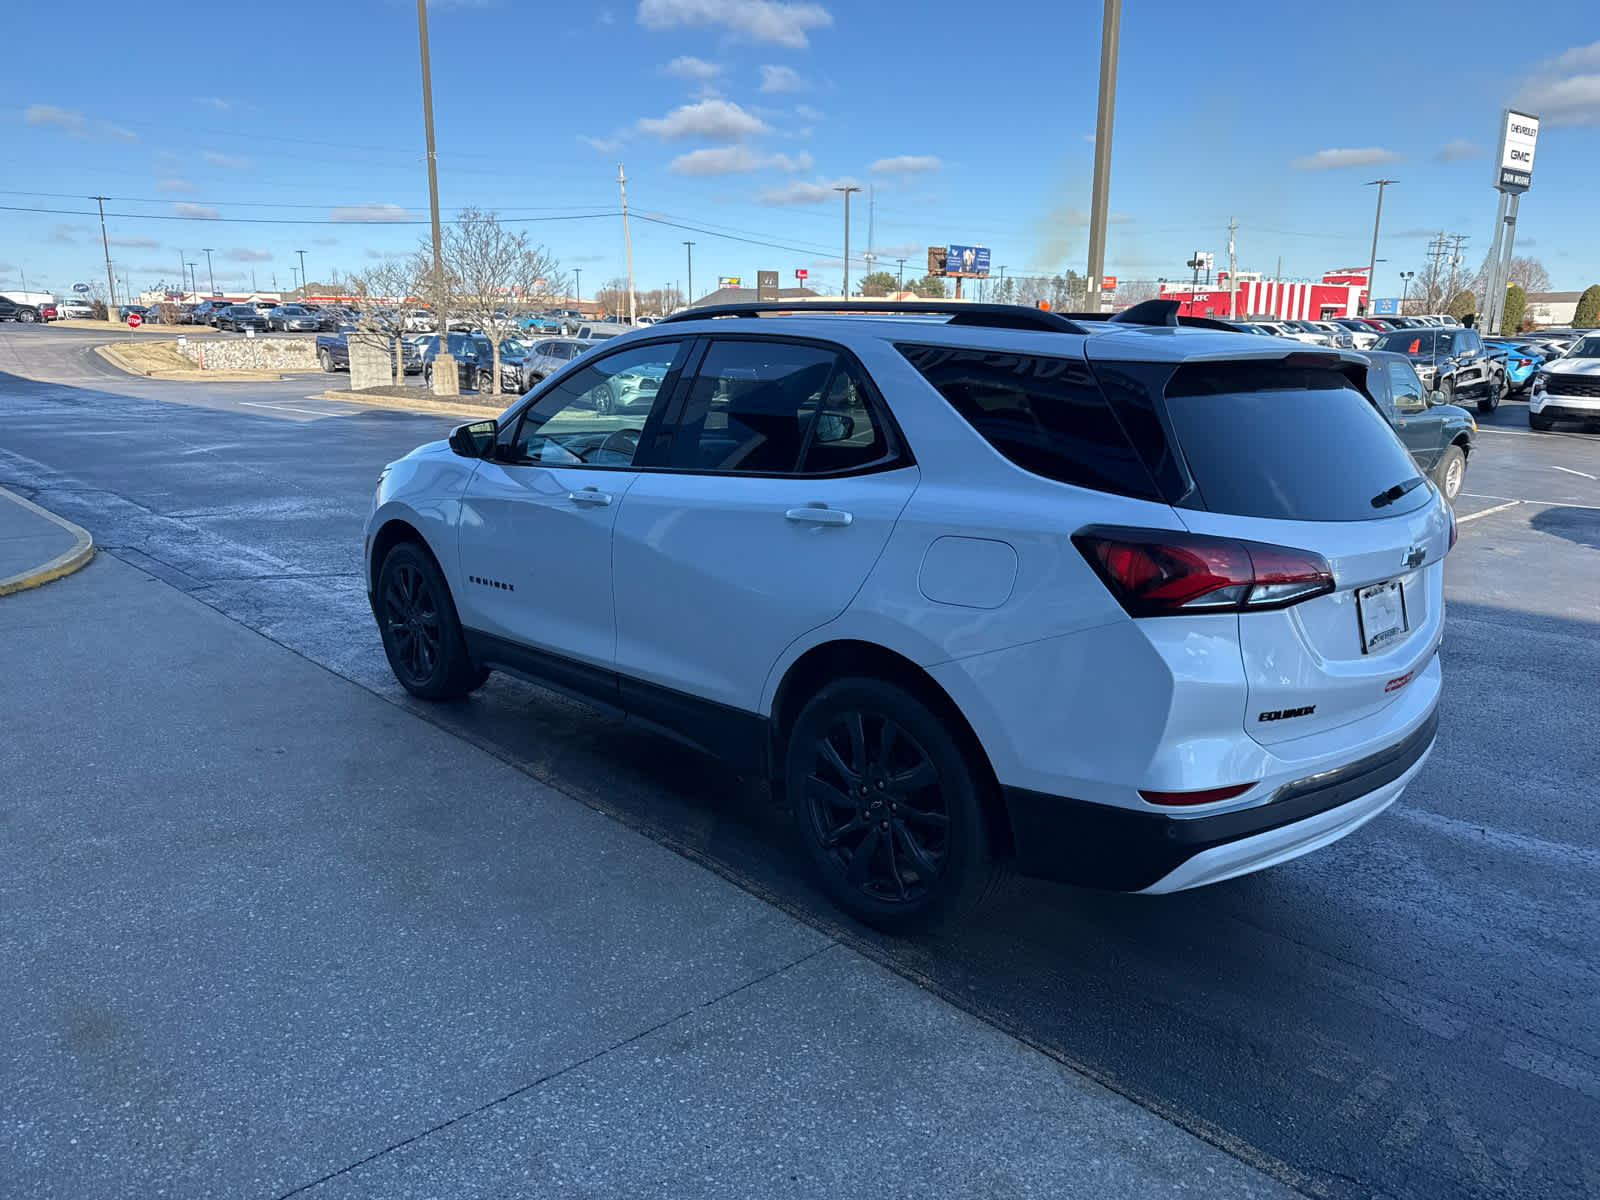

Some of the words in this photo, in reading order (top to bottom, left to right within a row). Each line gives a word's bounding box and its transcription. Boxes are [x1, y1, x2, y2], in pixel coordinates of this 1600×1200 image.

[1511, 123, 1536, 136] CHEVROLET
[1511, 150, 1530, 162] GMC
[1503, 172, 1514, 183] DON
[1514, 174, 1530, 185] MOORE
[1193, 294, 1210, 302] KFC
[468, 575, 515, 592] EQUINOX
[1258, 704, 1317, 722] EQUINOX
